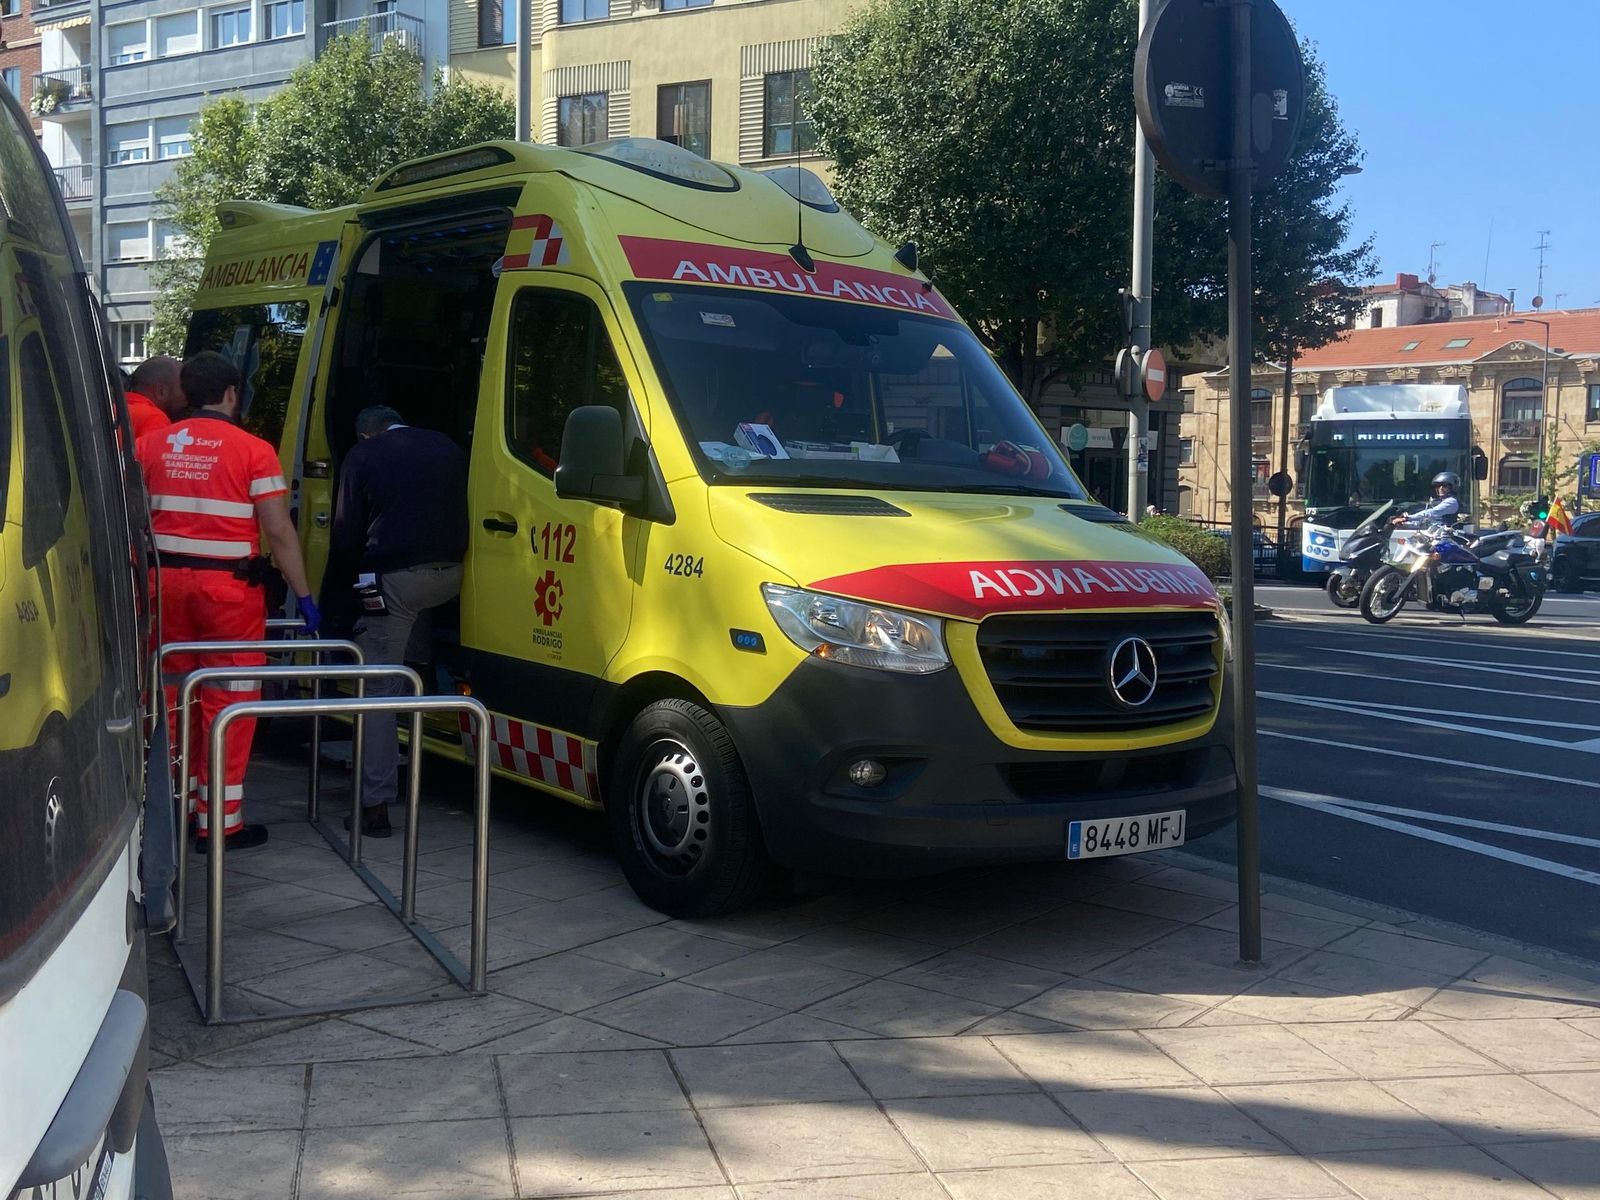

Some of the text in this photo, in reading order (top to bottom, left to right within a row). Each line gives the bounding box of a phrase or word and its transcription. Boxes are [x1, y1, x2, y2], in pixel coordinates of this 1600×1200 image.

[201, 252, 309, 290] AMBULANCIA
[672, 260, 940, 313] AMBULANCIA
[195, 437, 223, 448] Sacyl
[162, 453, 218, 463] EMERGENCIAS
[165, 461, 212, 470] SANITARIAS
[166, 469, 210, 480] TÉCNICO
[541, 522, 577, 563] 112
[664, 553, 704, 578] 4284
[532, 634, 563, 649] RODRIGO
[1085, 814, 1184, 852] 8448 MFJ
